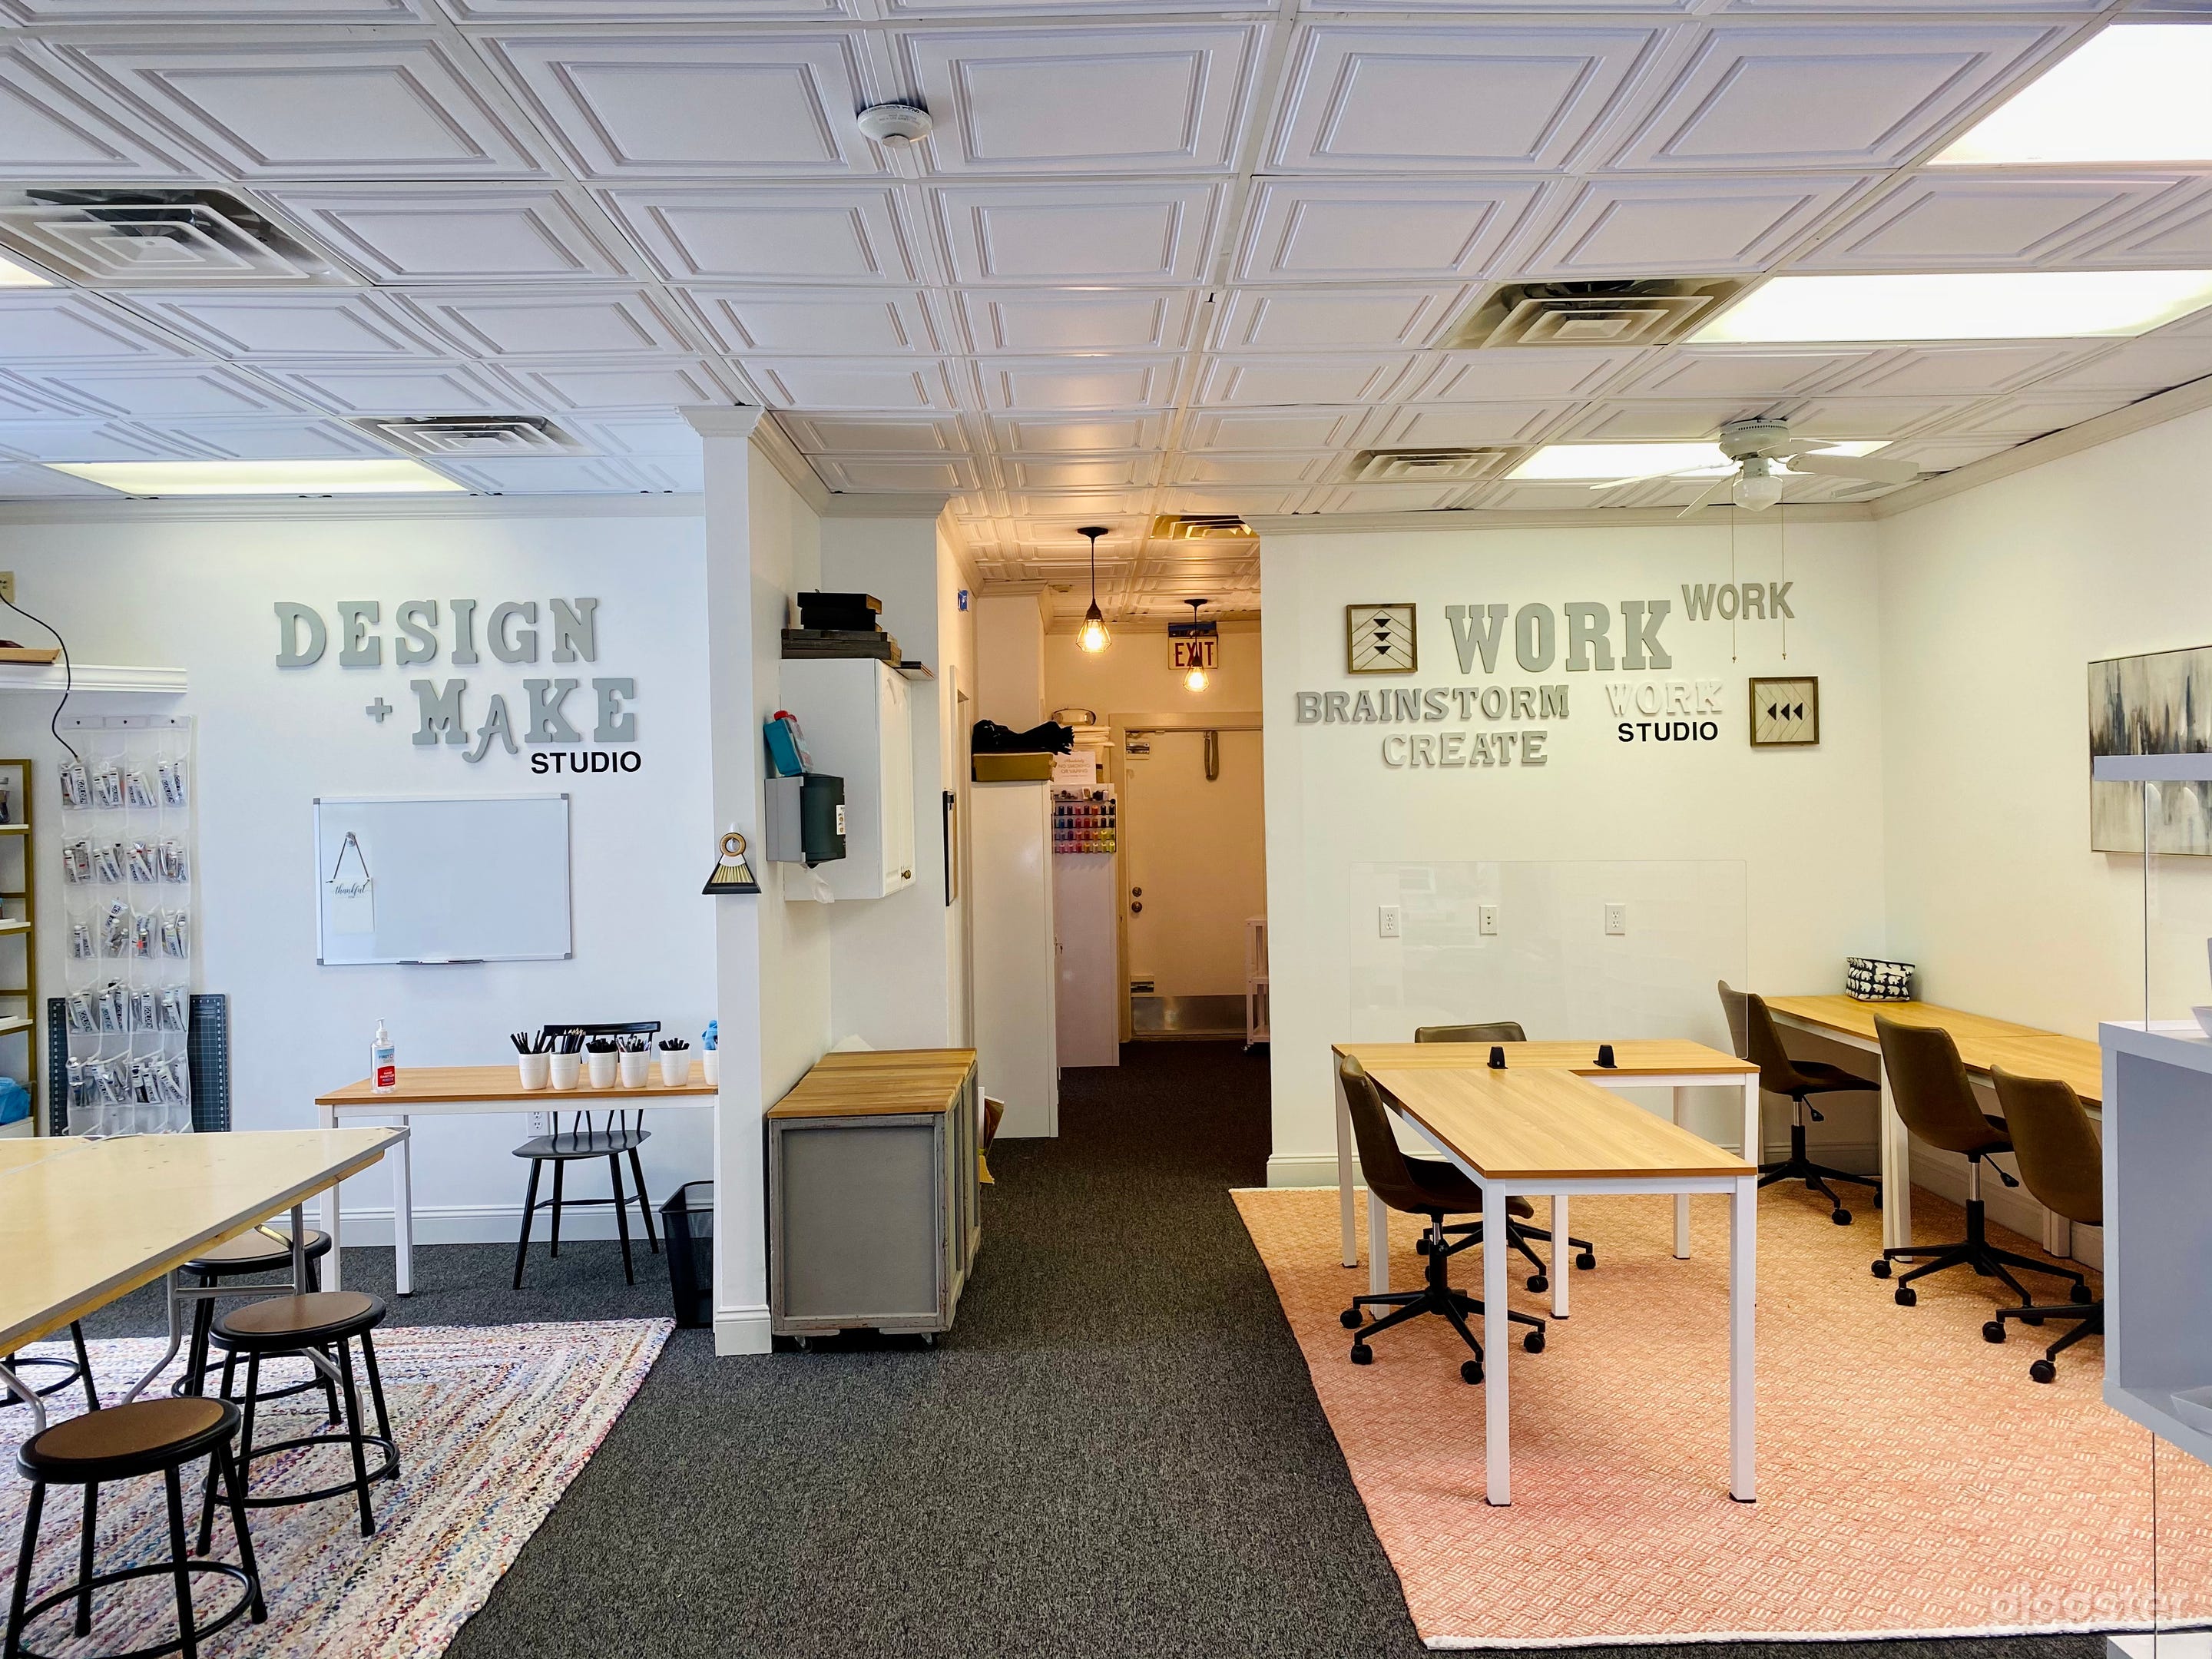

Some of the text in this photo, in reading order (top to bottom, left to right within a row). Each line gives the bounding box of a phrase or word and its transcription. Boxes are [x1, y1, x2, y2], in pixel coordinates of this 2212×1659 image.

[1681, 581, 1796, 621] WORK
[274, 598, 597, 667] DESIGN
[1445, 599, 1672, 674] WORK
[1174, 641, 1214, 667] EXIT
[1296, 684, 1570, 724] BRAINSTORM
[1604, 680, 1723, 717] WORK
[410, 677, 635, 763] MAKE
[1618, 721, 1718, 743] STUDIO
[531, 750, 641, 774] STUDIO
[1383, 730, 1548, 767] CREATE
